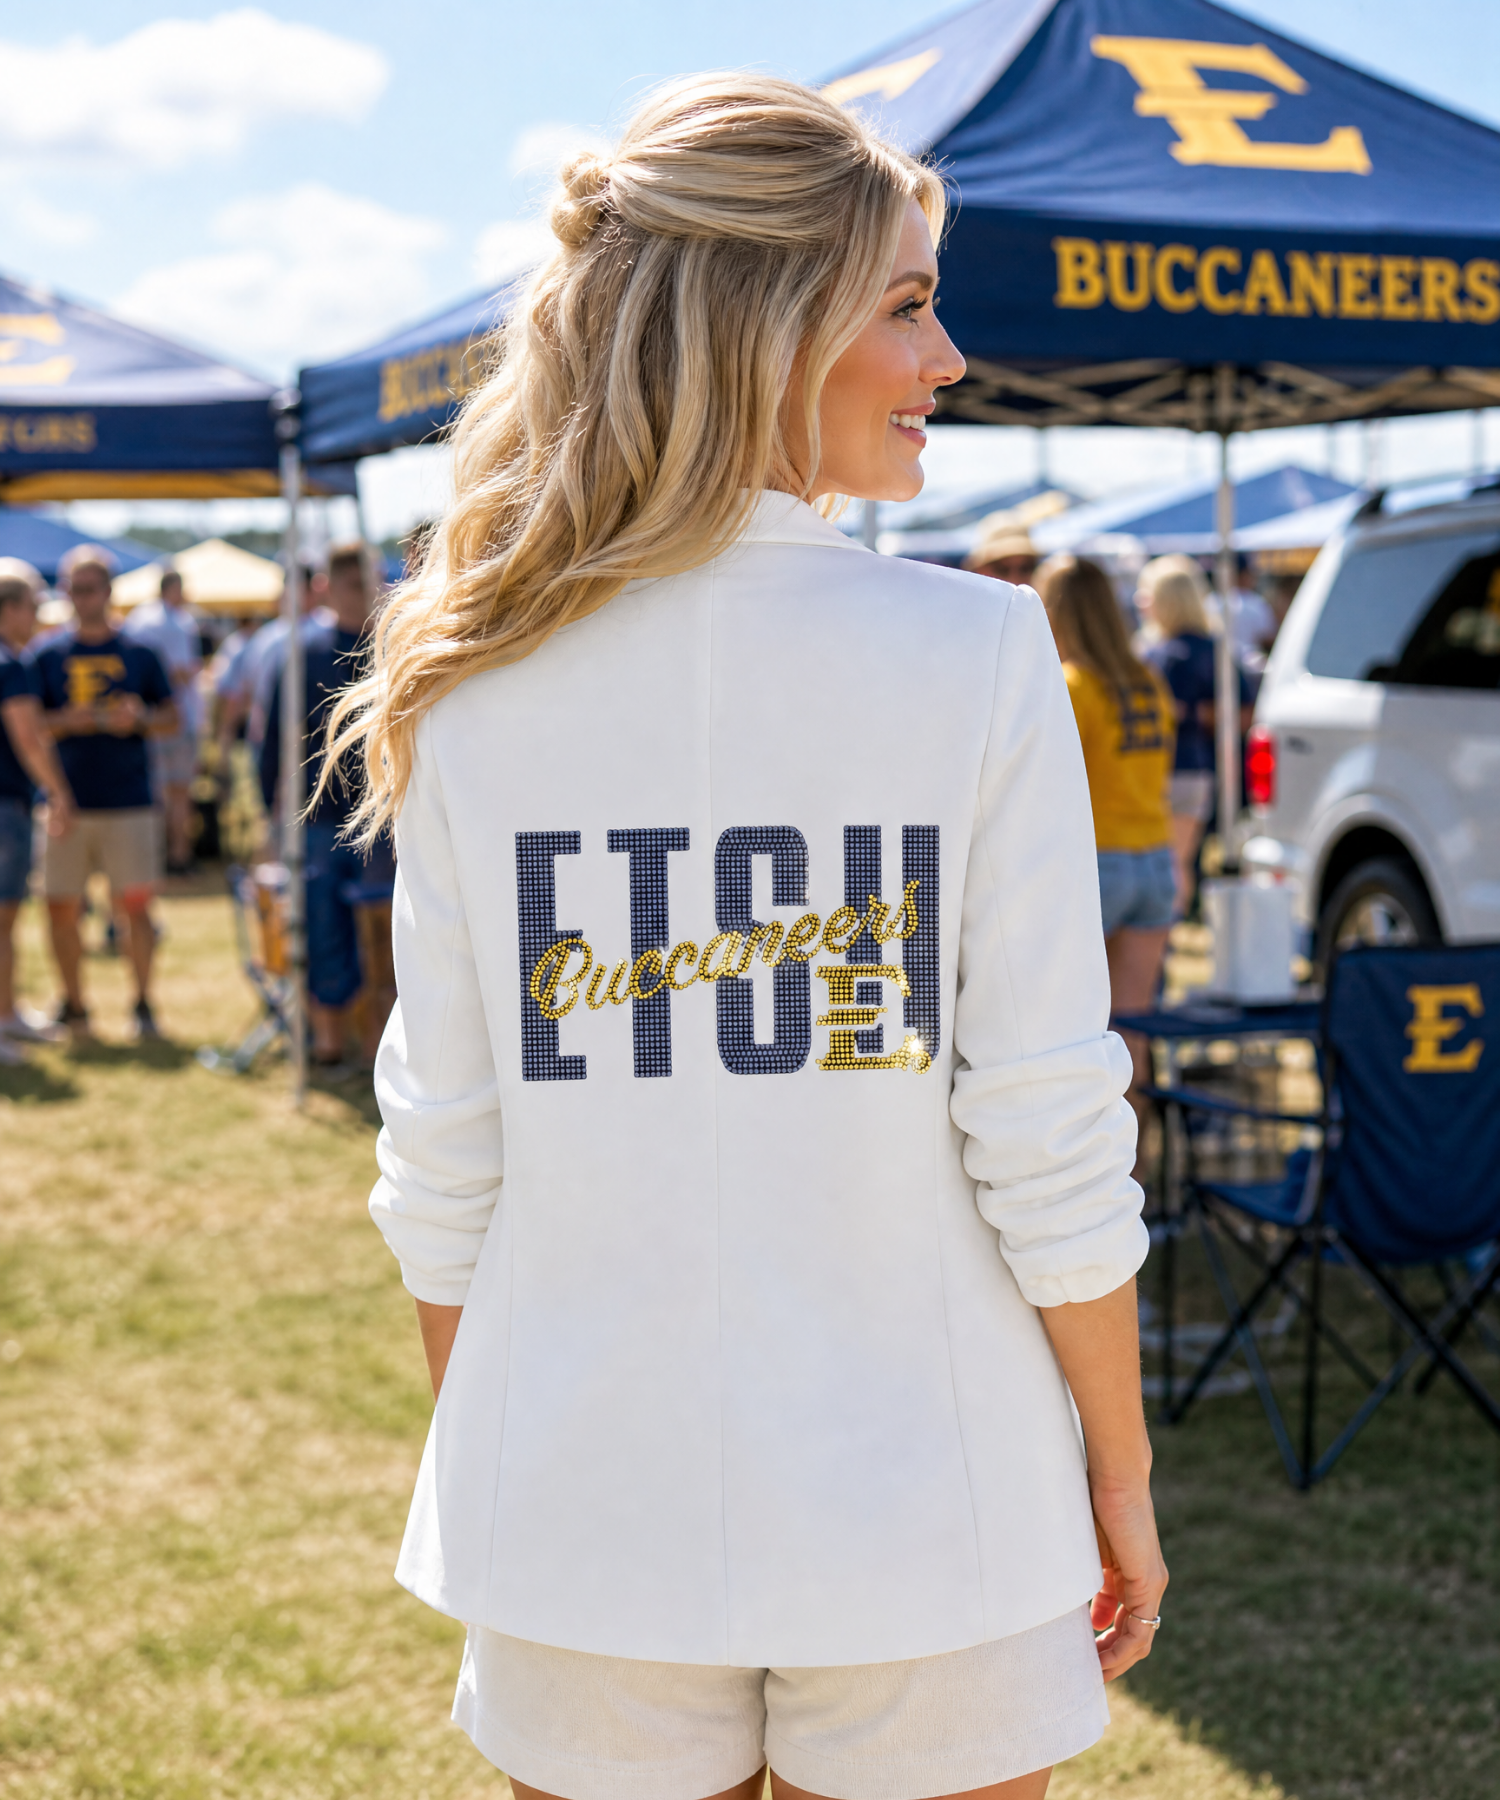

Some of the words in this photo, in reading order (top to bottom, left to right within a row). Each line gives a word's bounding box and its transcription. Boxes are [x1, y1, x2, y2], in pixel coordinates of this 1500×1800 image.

[1090, 34, 1373, 175] E
[1052, 235, 1500, 325] BUCCANEERS
[530, 880, 920, 1020] Buccaneers
[1402, 981, 1485, 1073] E
